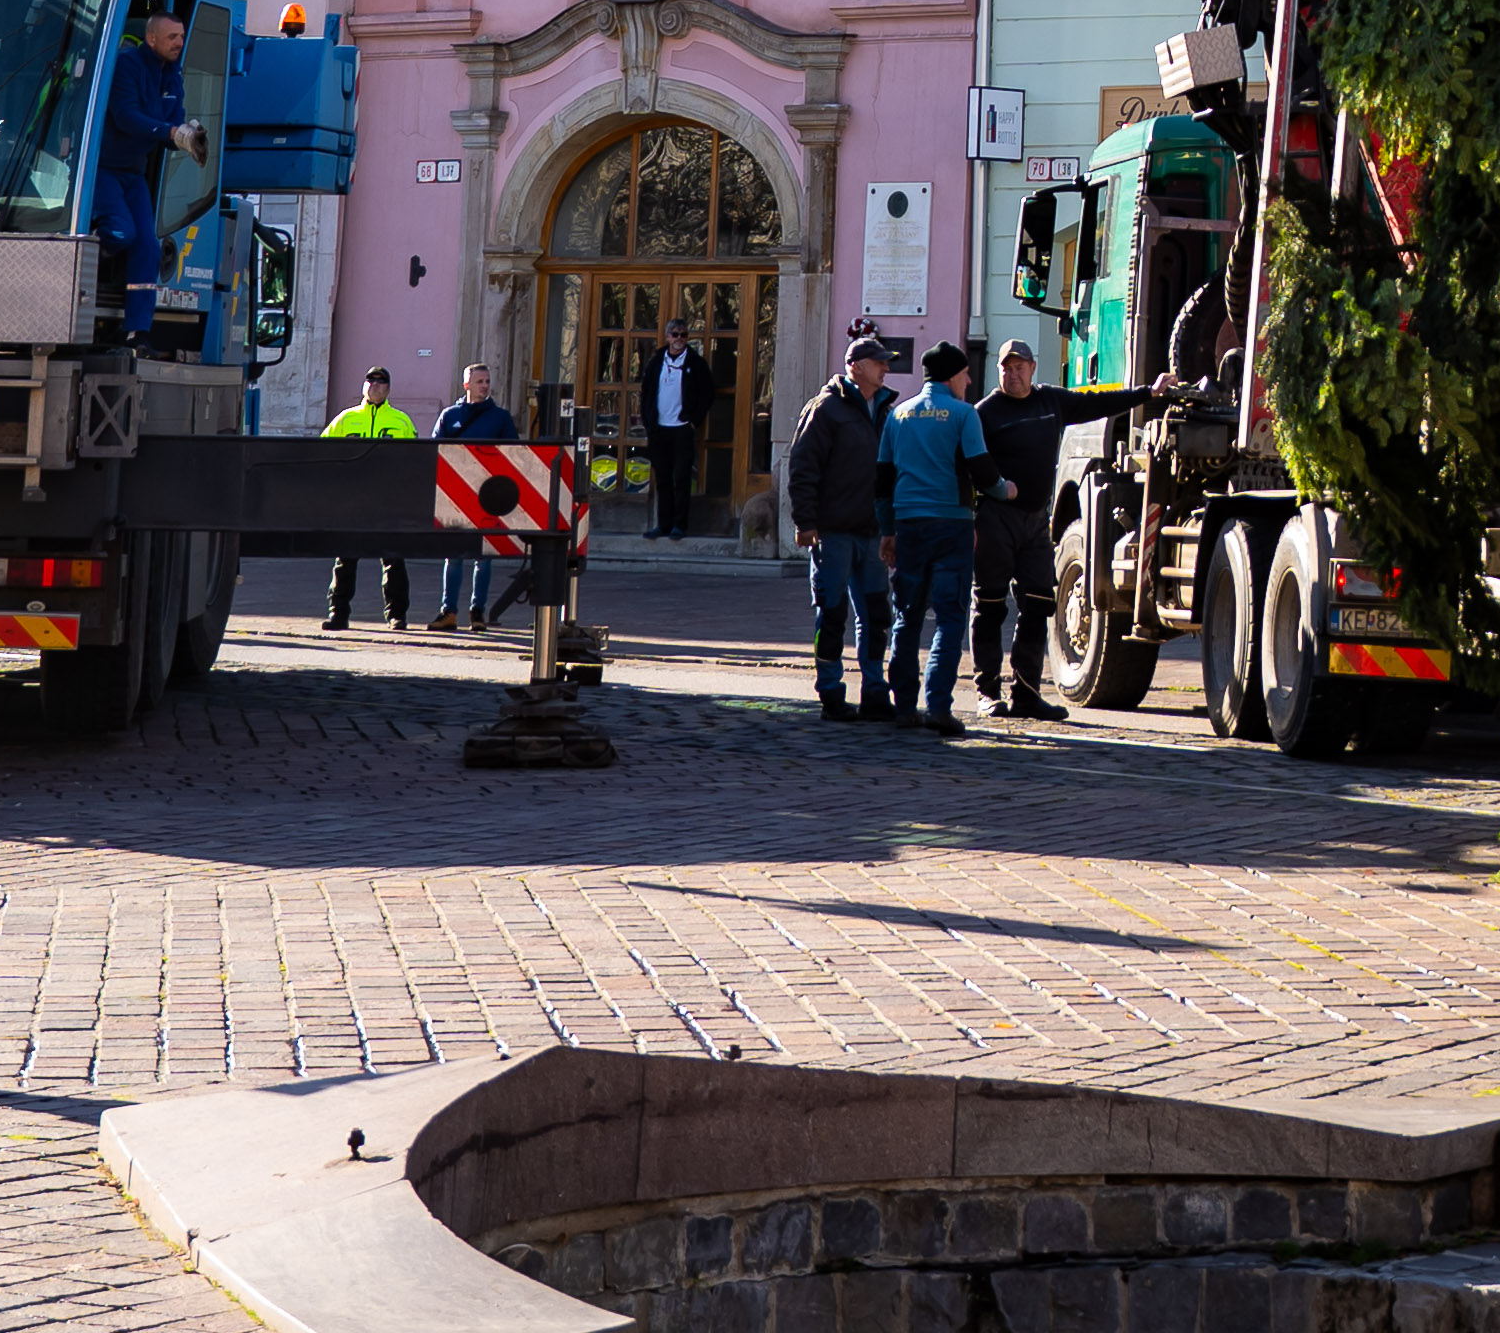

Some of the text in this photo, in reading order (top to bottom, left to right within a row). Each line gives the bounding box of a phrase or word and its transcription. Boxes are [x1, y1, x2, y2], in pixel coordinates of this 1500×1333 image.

[998, 111, 1015, 125] HAPPY
[998, 131, 1017, 146] BOTTLE
[421, 165, 432, 178] 68
[1032, 163, 1045, 176] 70
[1341, 610, 1366, 630] KE
